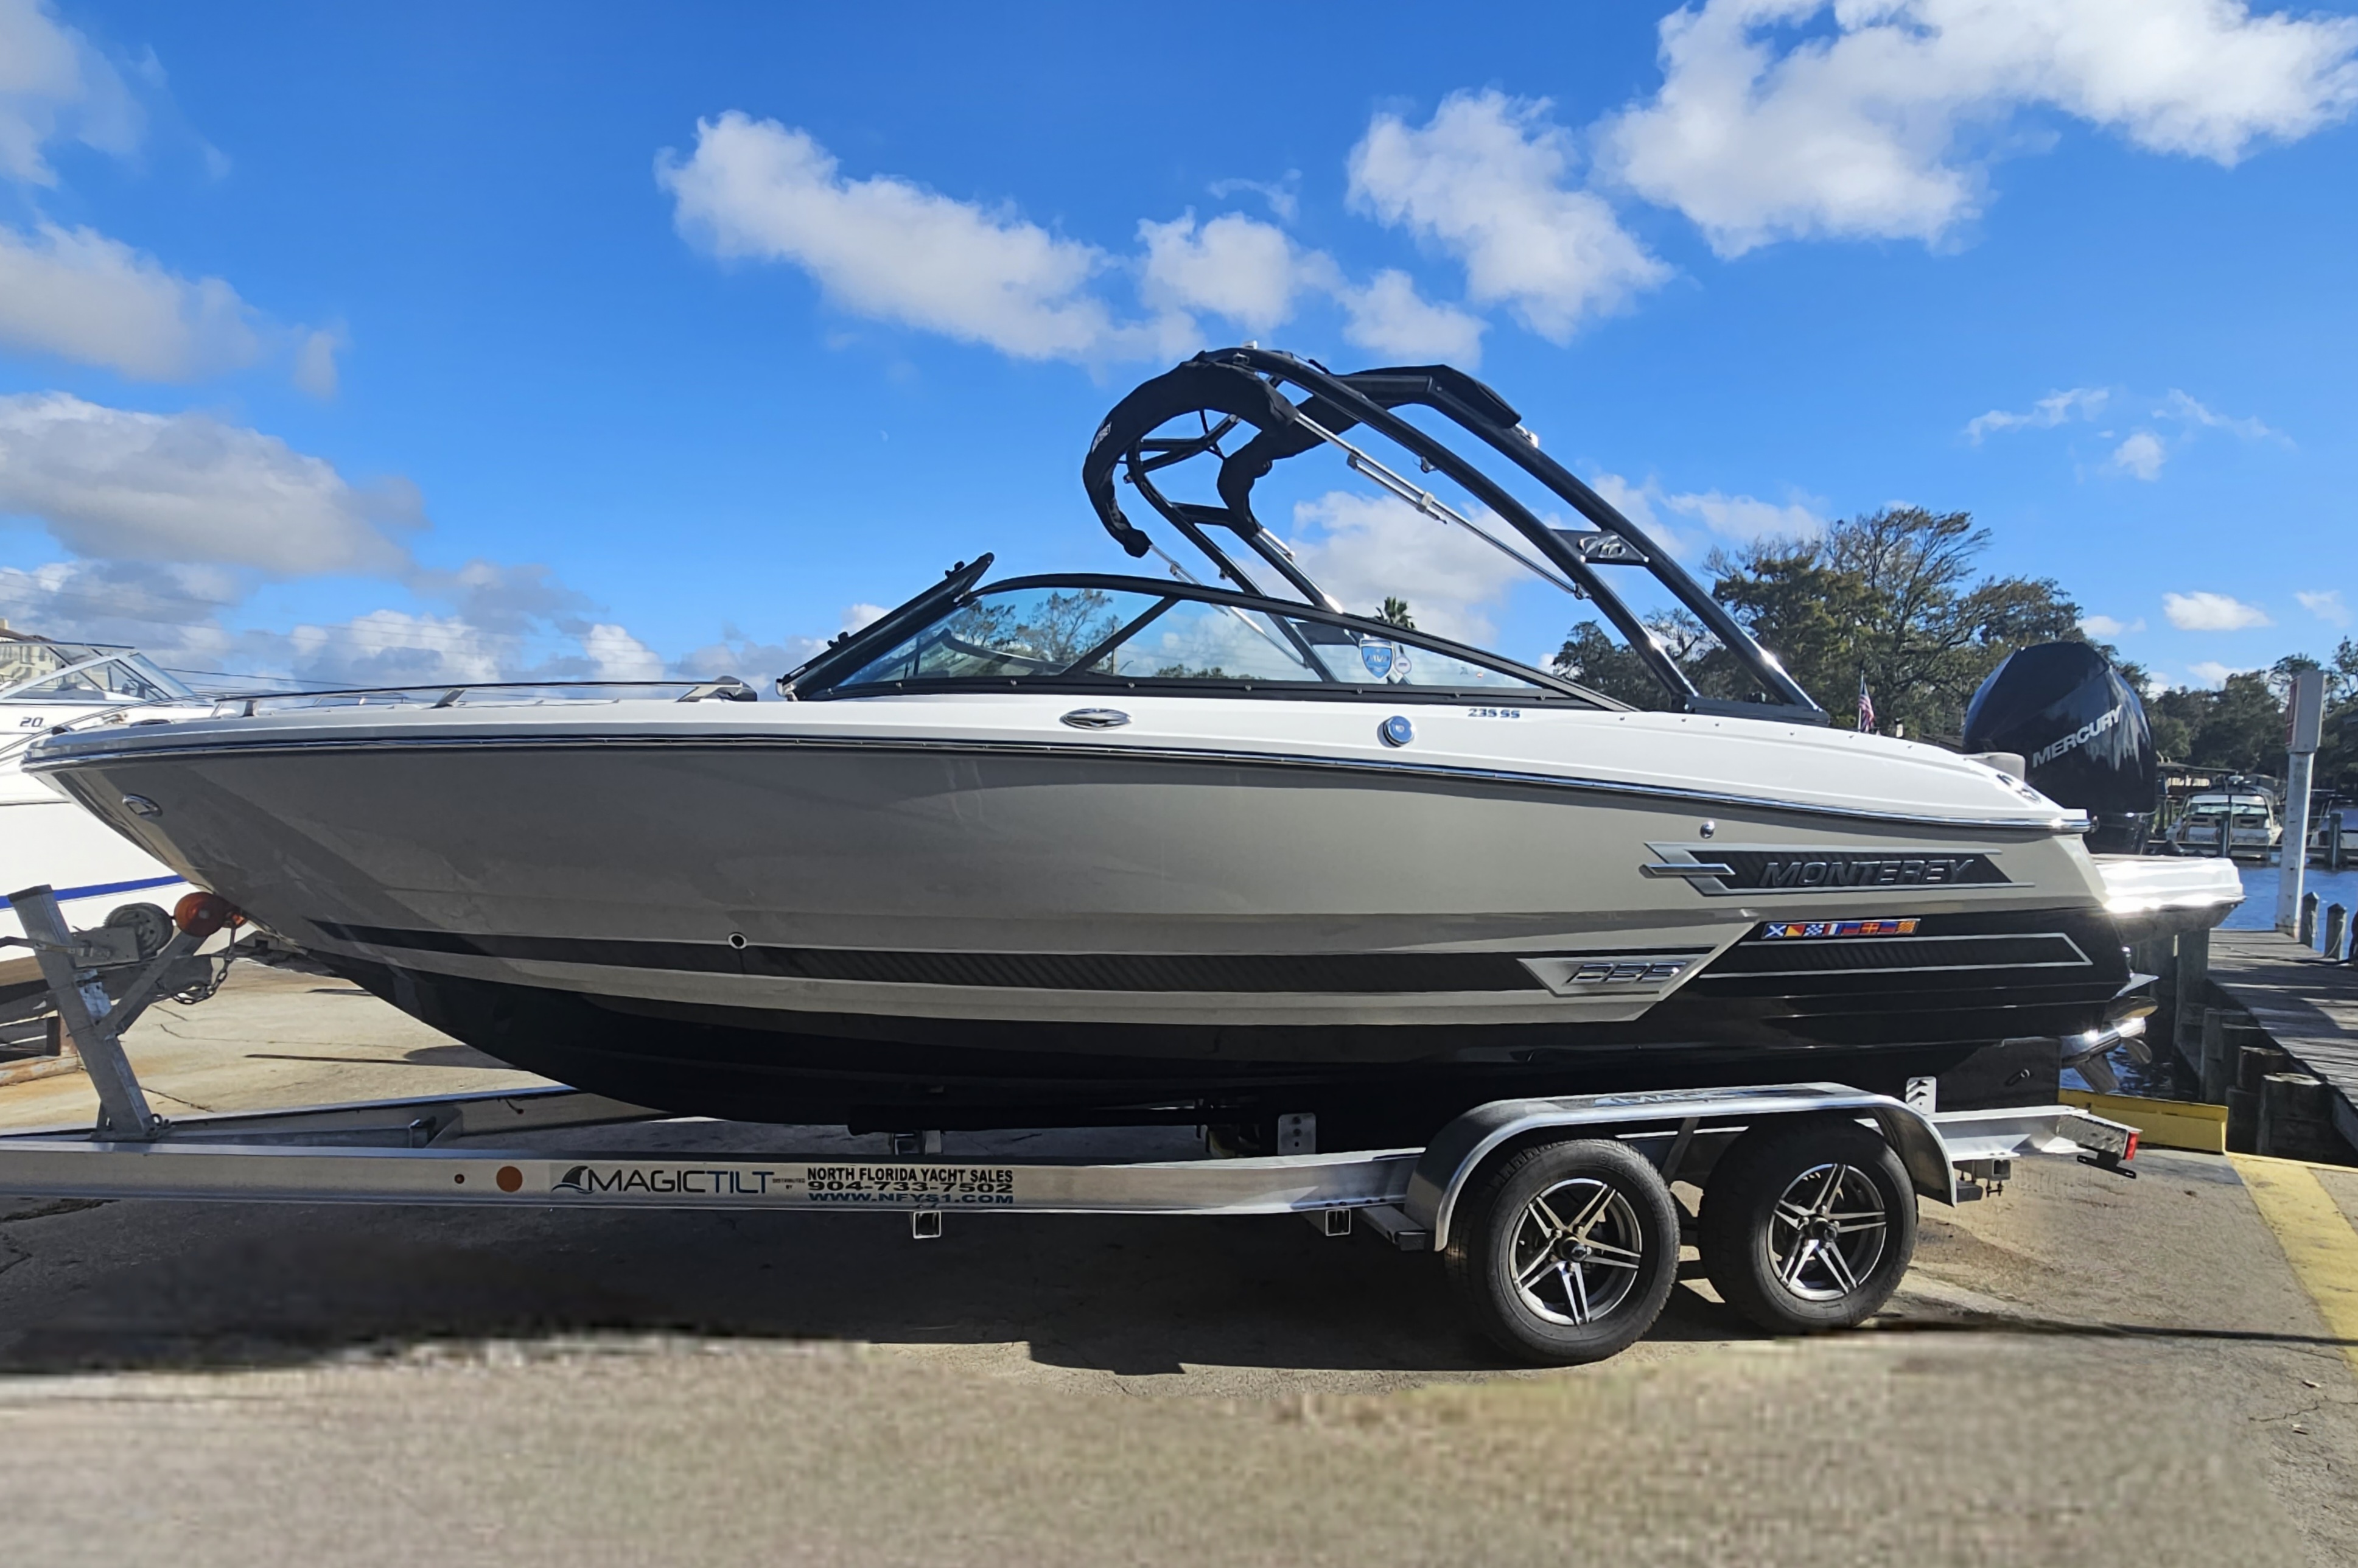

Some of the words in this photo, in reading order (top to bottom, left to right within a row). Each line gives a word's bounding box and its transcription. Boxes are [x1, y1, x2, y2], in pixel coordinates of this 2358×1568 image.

[19, 716, 44, 727] 20
[2032, 704, 2122, 768] MERCURY
[1759, 859, 1975, 887] MONTEREY
[587, 1169, 775, 1194] MAGICTILT
[807, 1167, 855, 1181] NORTH
[859, 1167, 917, 1181] FLORIDA
[920, 1168, 967, 1182] YACHT
[970, 1169, 1013, 1183] SALES
[807, 1181, 1013, 1194] 904-733-7502
[808, 1192, 1014, 1204] WWW.NFYS1.COM
